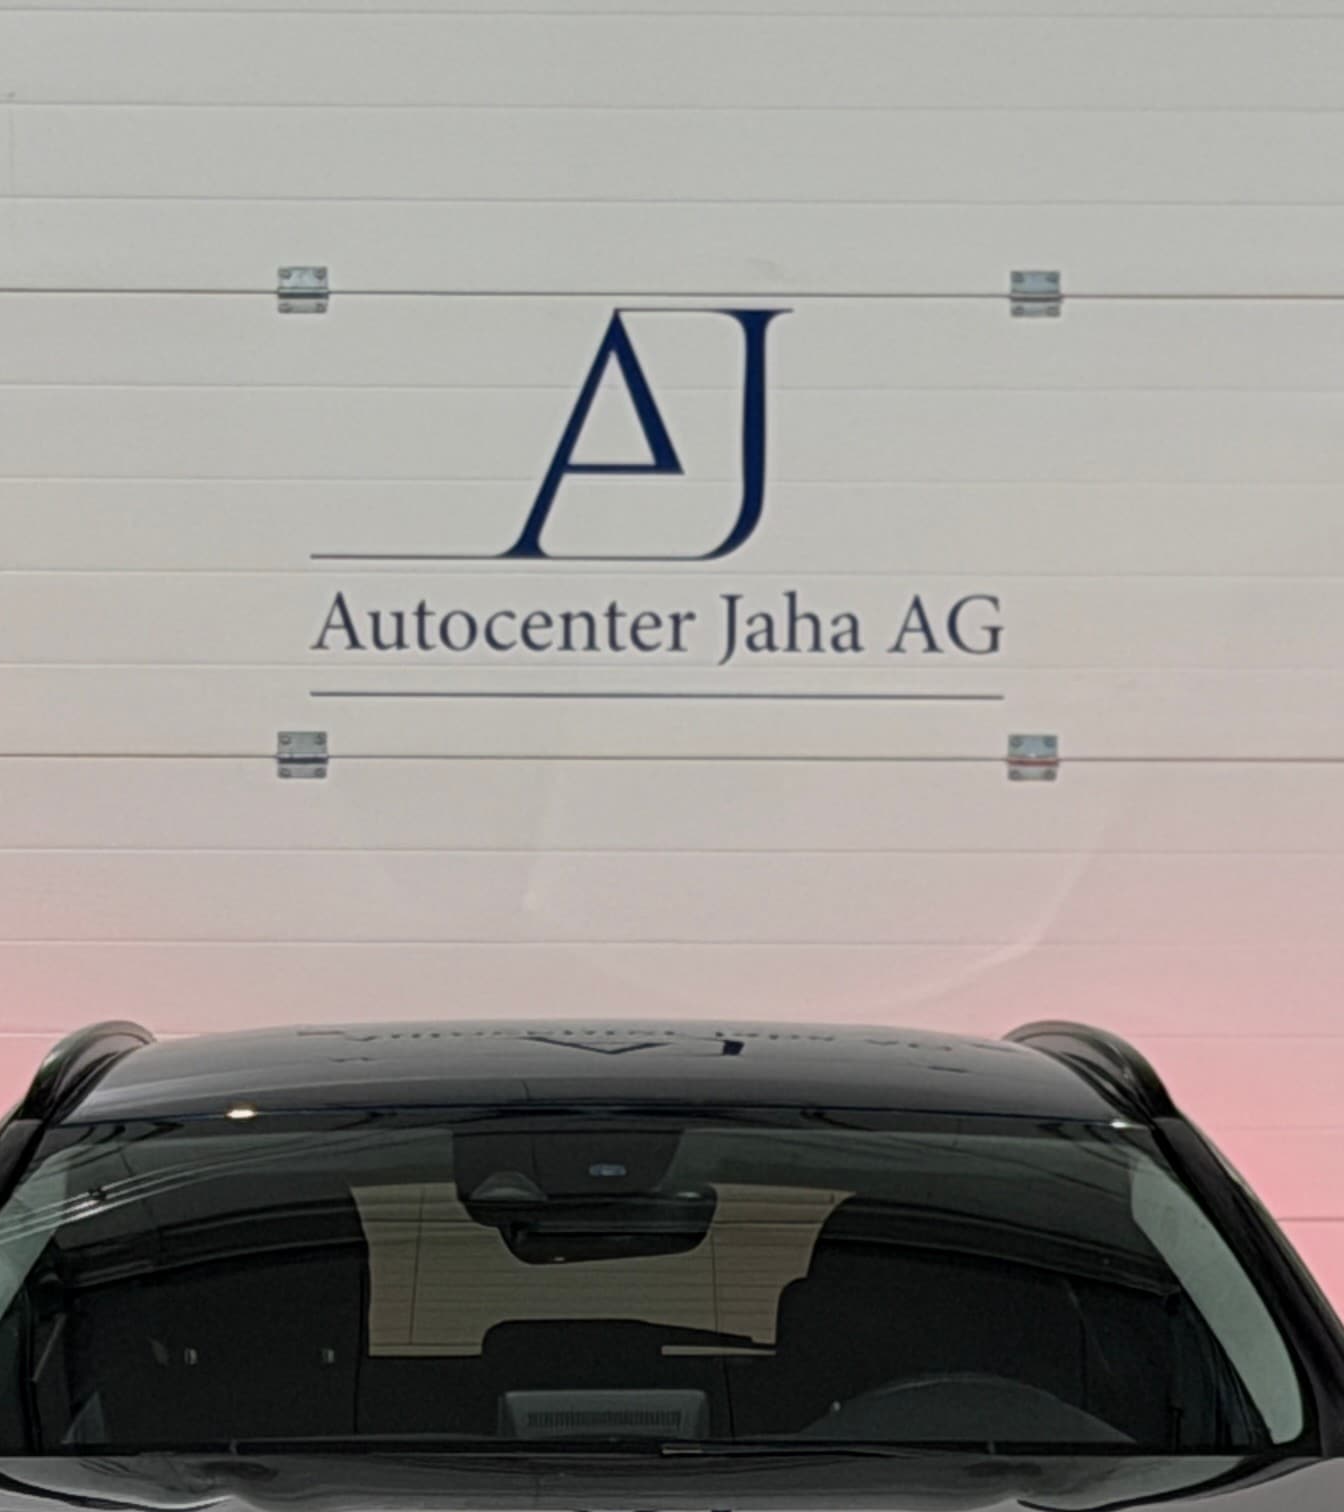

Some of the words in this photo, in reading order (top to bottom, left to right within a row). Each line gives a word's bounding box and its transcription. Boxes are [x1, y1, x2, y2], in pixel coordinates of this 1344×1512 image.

[492, 307, 795, 561] AJ
[310, 590, 697, 653] Autocenter
[716, 589, 866, 666] Jaha
[886, 593, 1005, 656] AG
